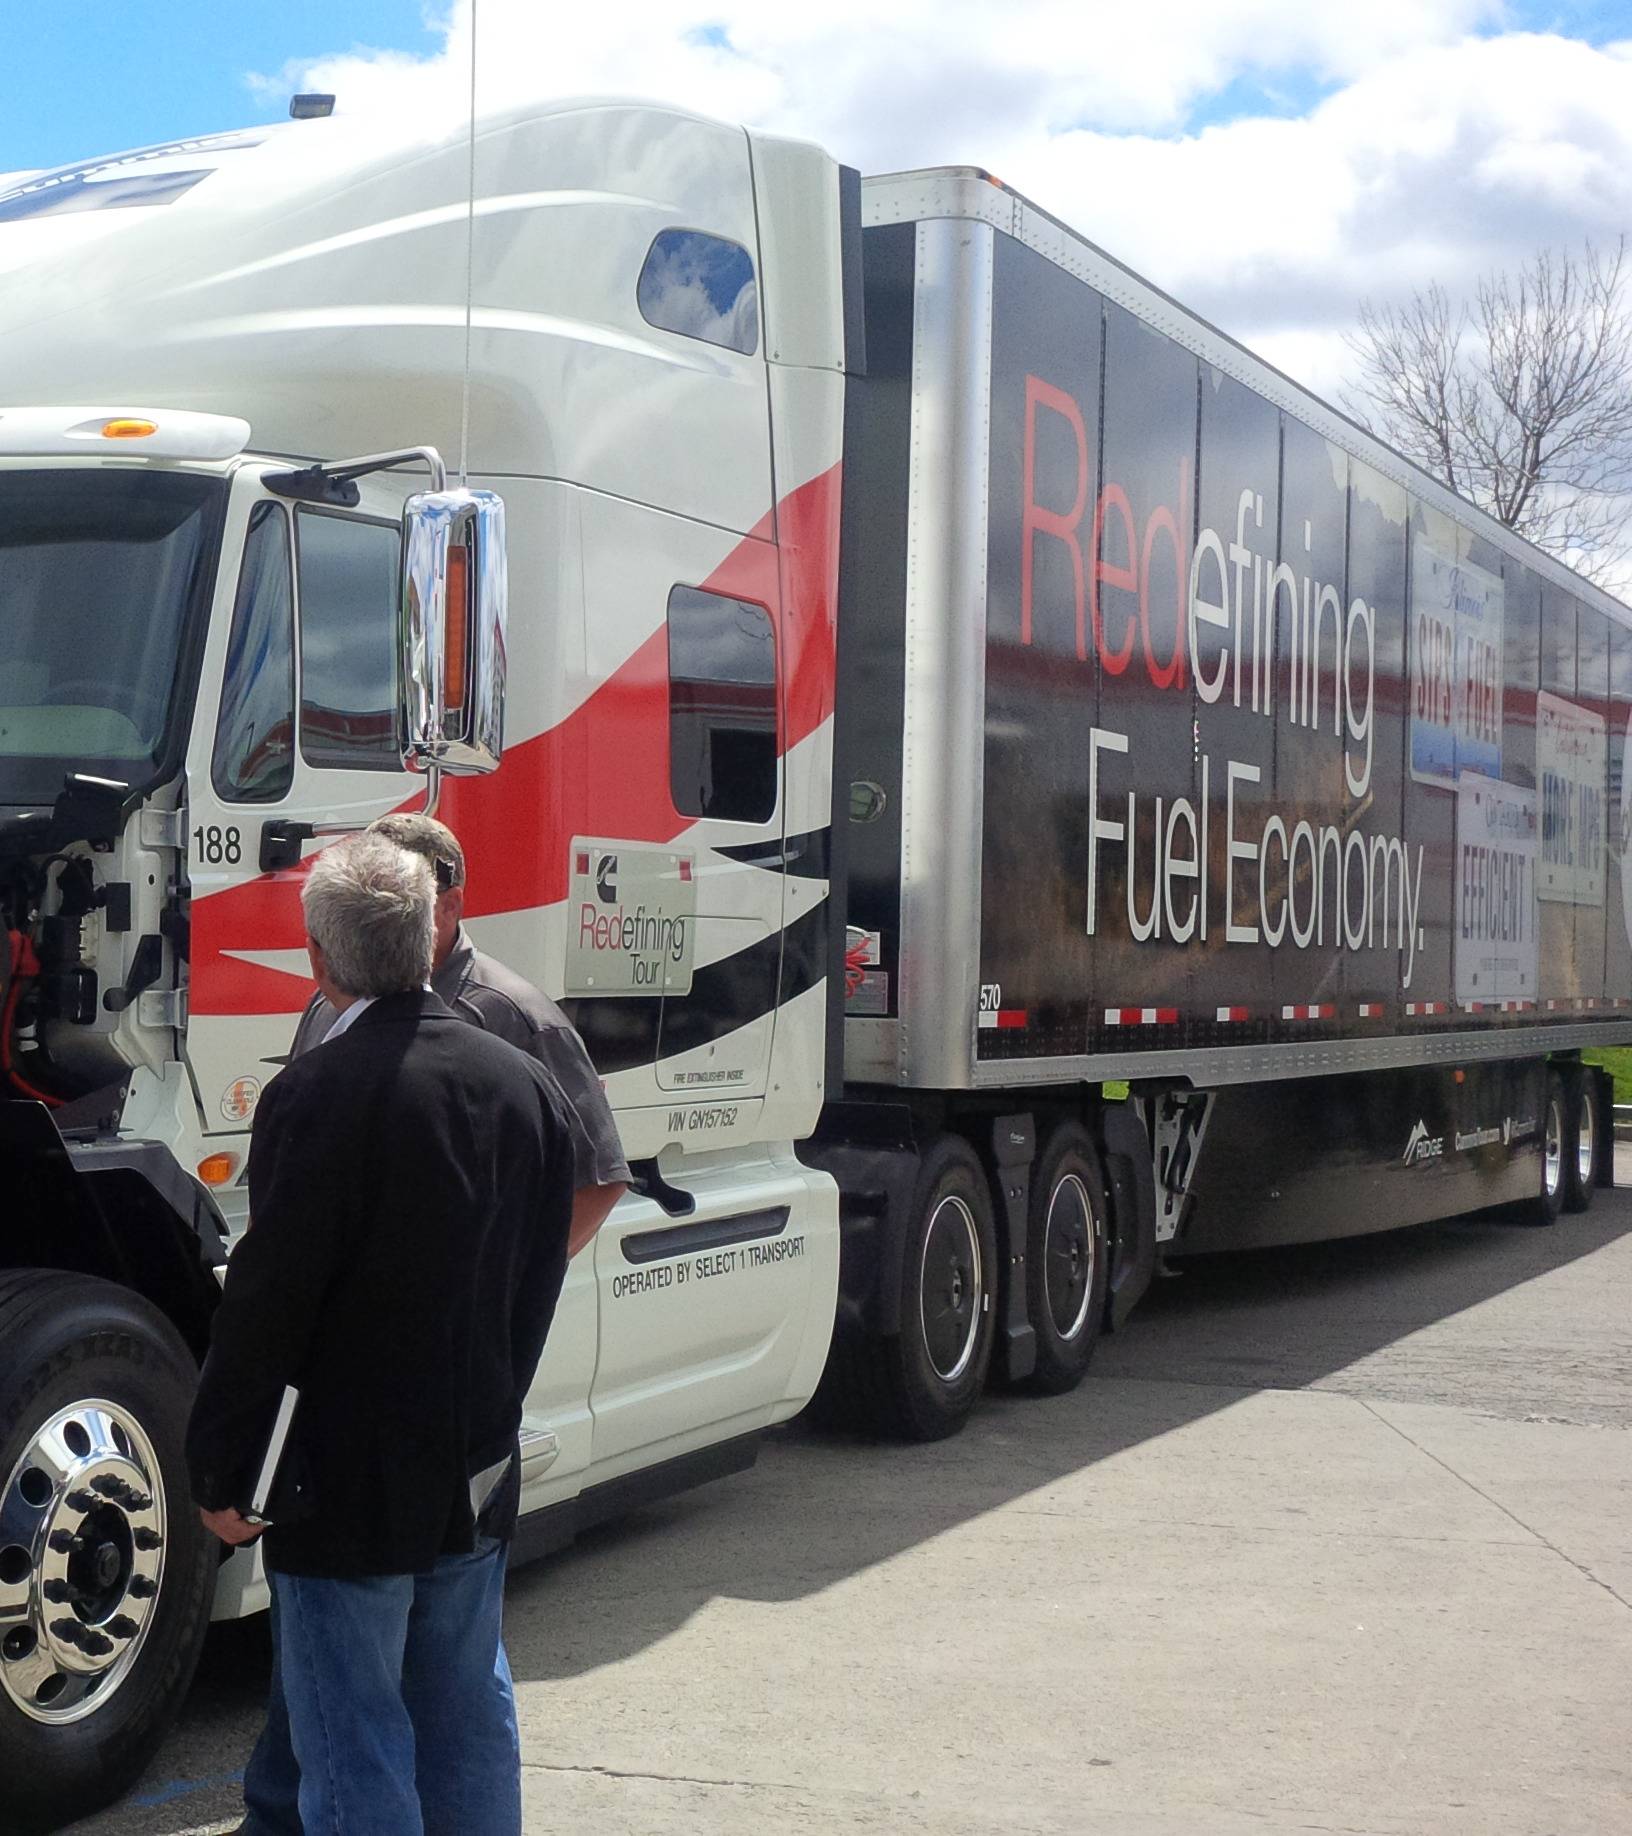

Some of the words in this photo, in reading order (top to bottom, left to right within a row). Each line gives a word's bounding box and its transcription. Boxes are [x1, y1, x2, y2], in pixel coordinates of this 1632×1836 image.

[1021, 374, 1375, 798] Redefining
[1466, 636, 1498, 745] FUEL
[193, 826, 242, 864] 188
[1086, 727, 1209, 944] Fuel
[1225, 760, 1424, 989] Economy.
[579, 903, 685, 962] Redefining
[629, 953, 660, 985] Tour
[979, 983, 1001, 1010] 570
[668, 1110, 687, 1132] VIN
[688, 1107, 738, 1130] GN157152
[612, 1265, 673, 1299] OPERATED
[676, 1260, 692, 1284] BY
[695, 1251, 736, 1280] SELECT
[739, 1249, 746, 1269] 1
[748, 1236, 805, 1267] TRANSPORT
